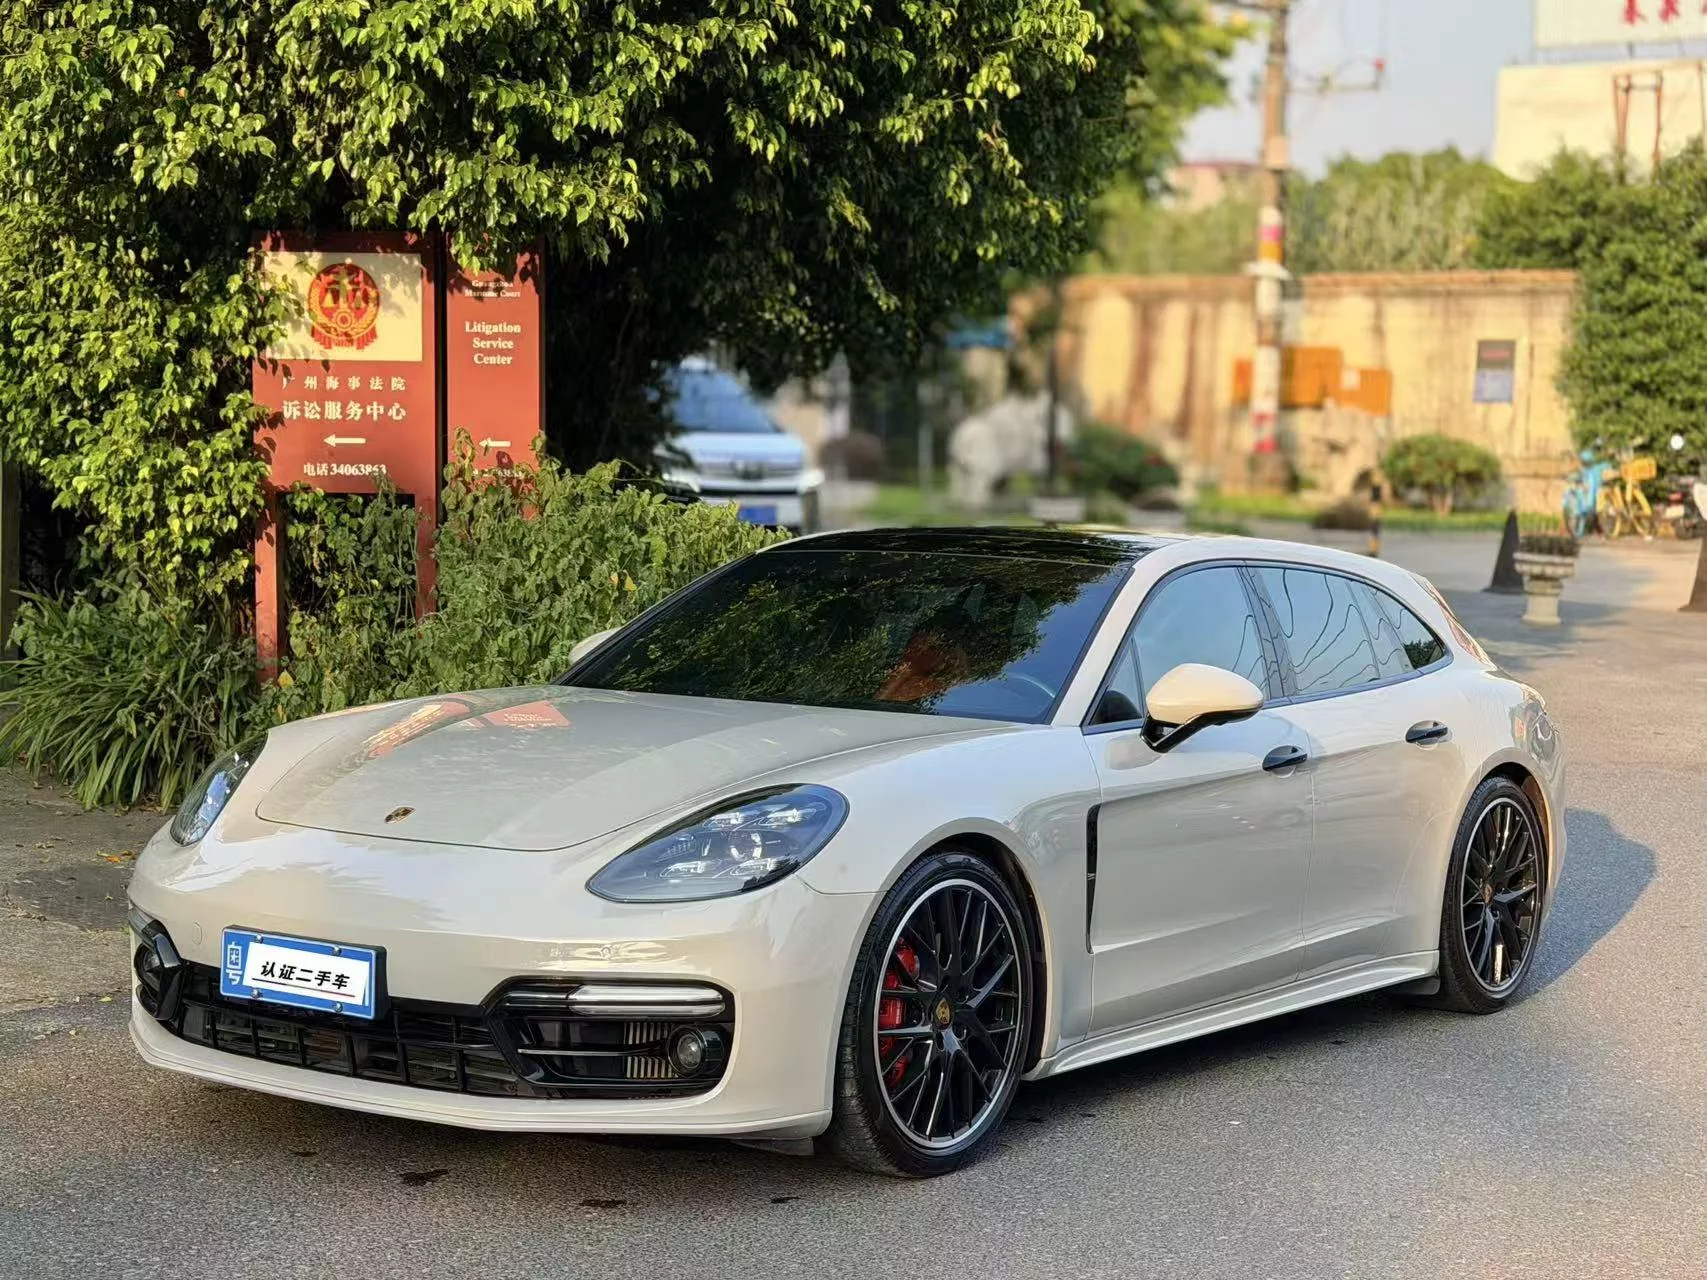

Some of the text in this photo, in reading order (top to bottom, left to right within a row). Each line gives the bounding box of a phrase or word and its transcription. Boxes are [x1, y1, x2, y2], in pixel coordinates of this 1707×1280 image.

[464, 321, 521, 335] Litigation
[472, 337, 514, 348] Service
[473, 353, 513, 364] Center
[282, 375, 406, 391] 广州海事法院
[282, 400, 407, 421] 诉讼服务中心
[226, 941, 243, 985] 粤
